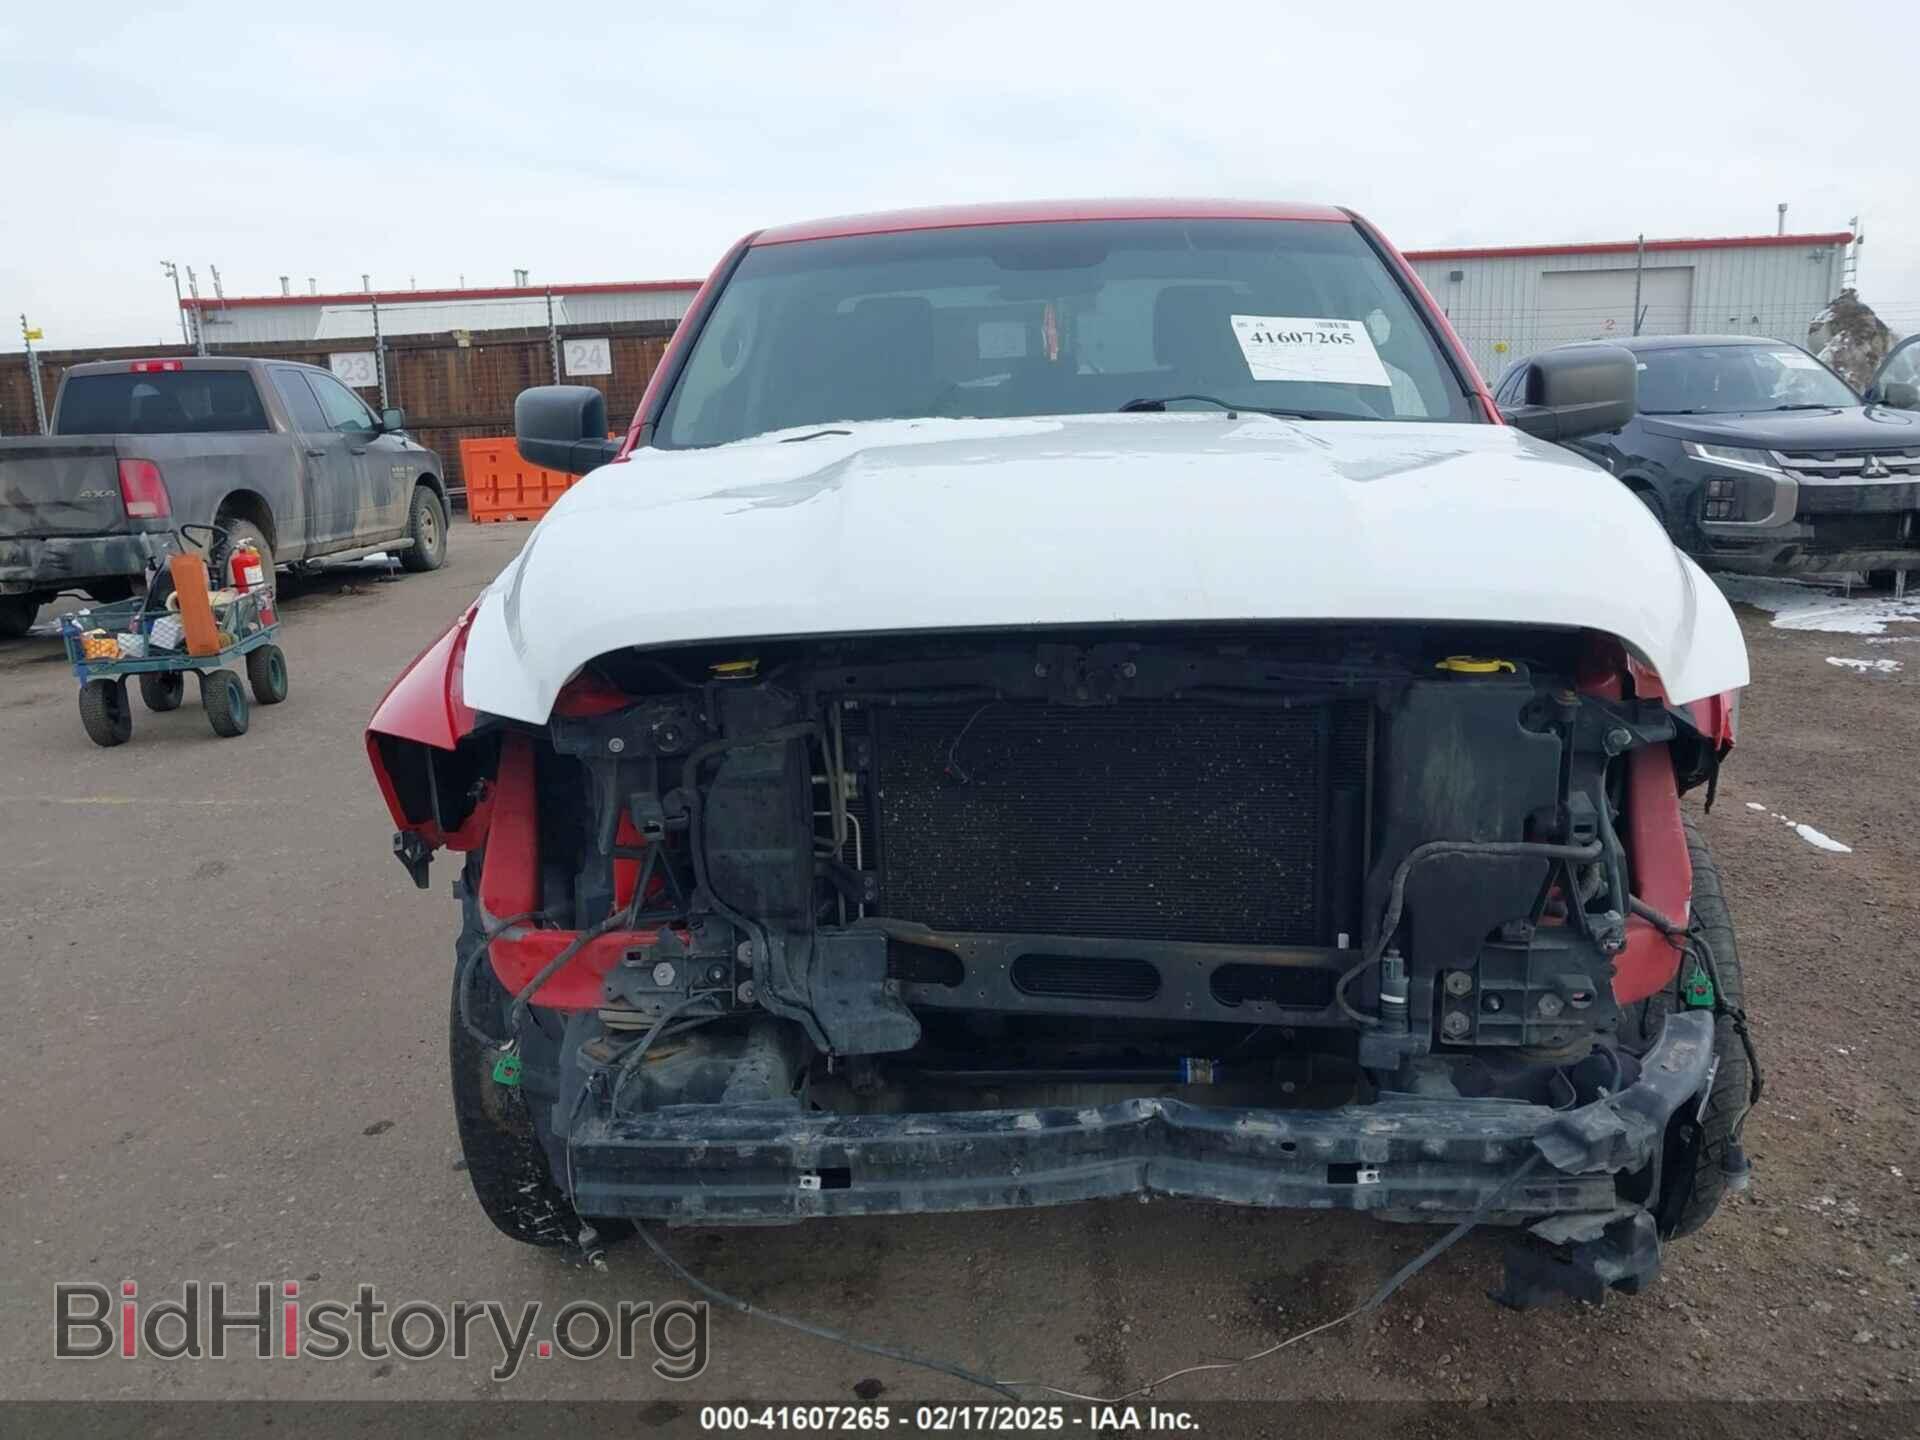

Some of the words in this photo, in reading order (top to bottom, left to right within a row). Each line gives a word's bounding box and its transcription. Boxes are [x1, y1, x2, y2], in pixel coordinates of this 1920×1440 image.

[1250, 331, 1355, 344] 41607265
[572, 343, 605, 369] 24
[339, 357, 370, 382] 23
